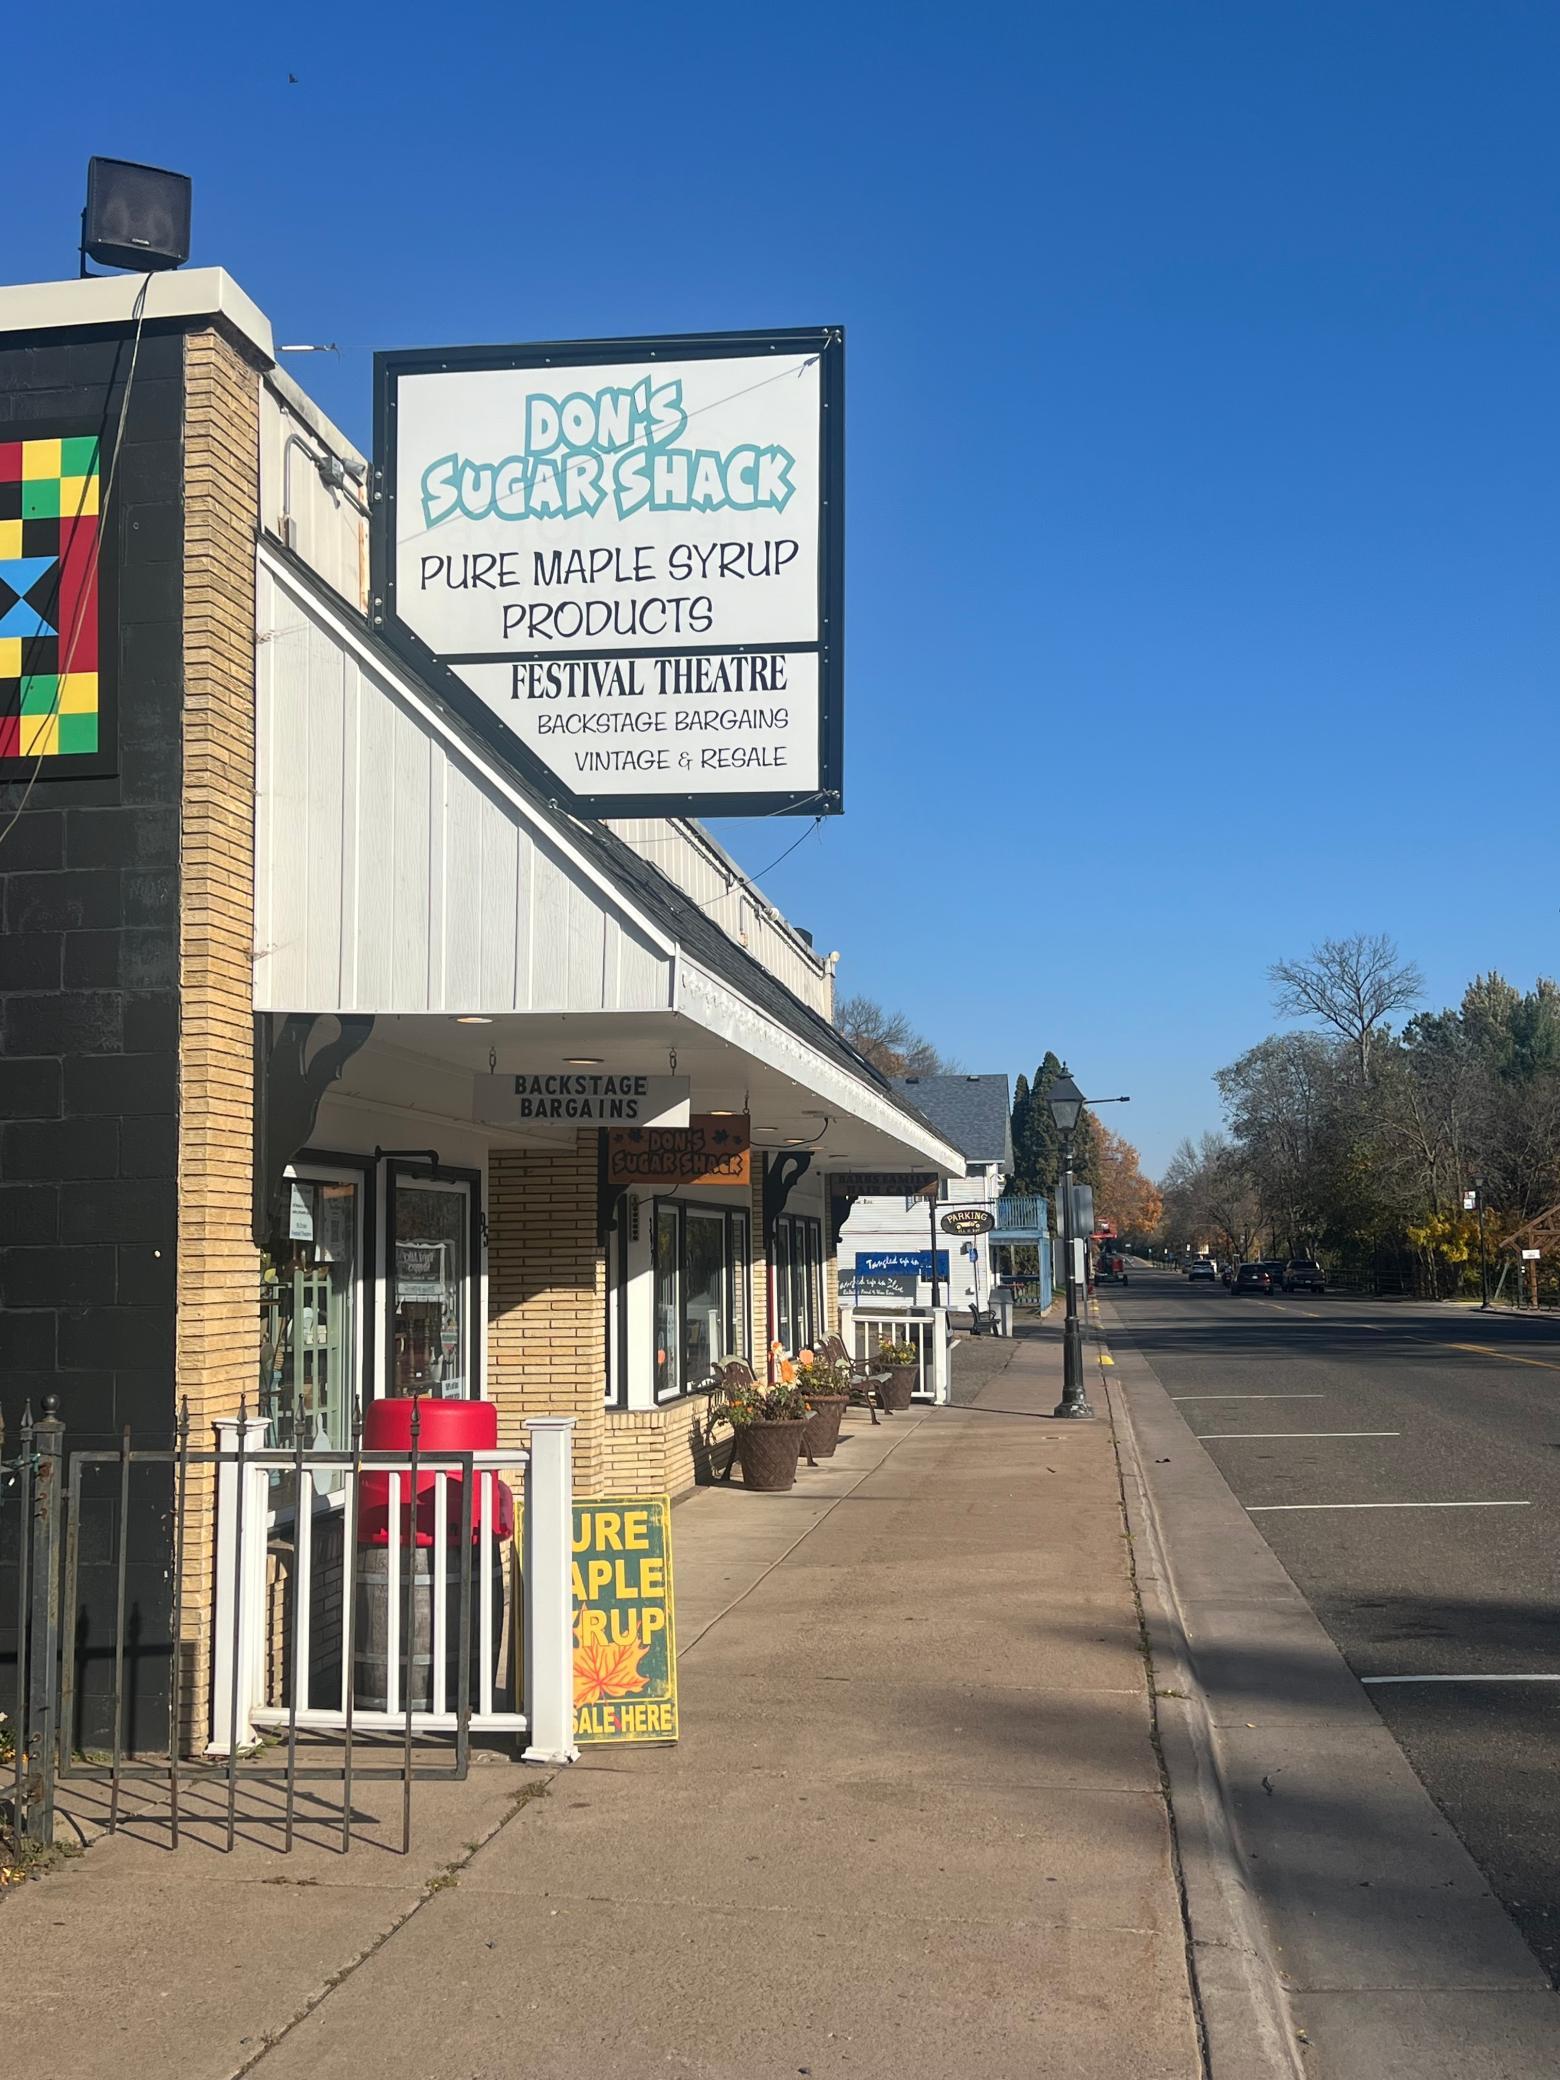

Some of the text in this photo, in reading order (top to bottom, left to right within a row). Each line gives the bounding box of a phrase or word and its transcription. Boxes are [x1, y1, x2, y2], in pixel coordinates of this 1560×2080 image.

[525, 374, 687, 456] DON'S
[421, 444, 796, 529] SUGAR SHACK
[420, 539, 799, 590] PURE MAPLE SYRUP
[502, 596, 713, 640] PRODUCTS
[511, 655, 788, 699] FESTIVAL THEATRE
[538, 708, 789, 735] BACKSTAGE BARGAINS
[574, 746, 788, 772] VINTAGE & RESALE
[514, 1075, 648, 1097] BACKSTAGE
[520, 1099, 639, 1119] BARGAINS
[649, 1127, 705, 1151] DON'S
[612, 1149, 743, 1176] SUGAR SHACK
[946, 1211, 989, 1224] PARKING
[572, 1511, 649, 1552] URE
[572, 1558, 665, 1601] APLE
[573, 1607, 665, 1647] RUP
[621, 1703, 672, 1732] HERE
